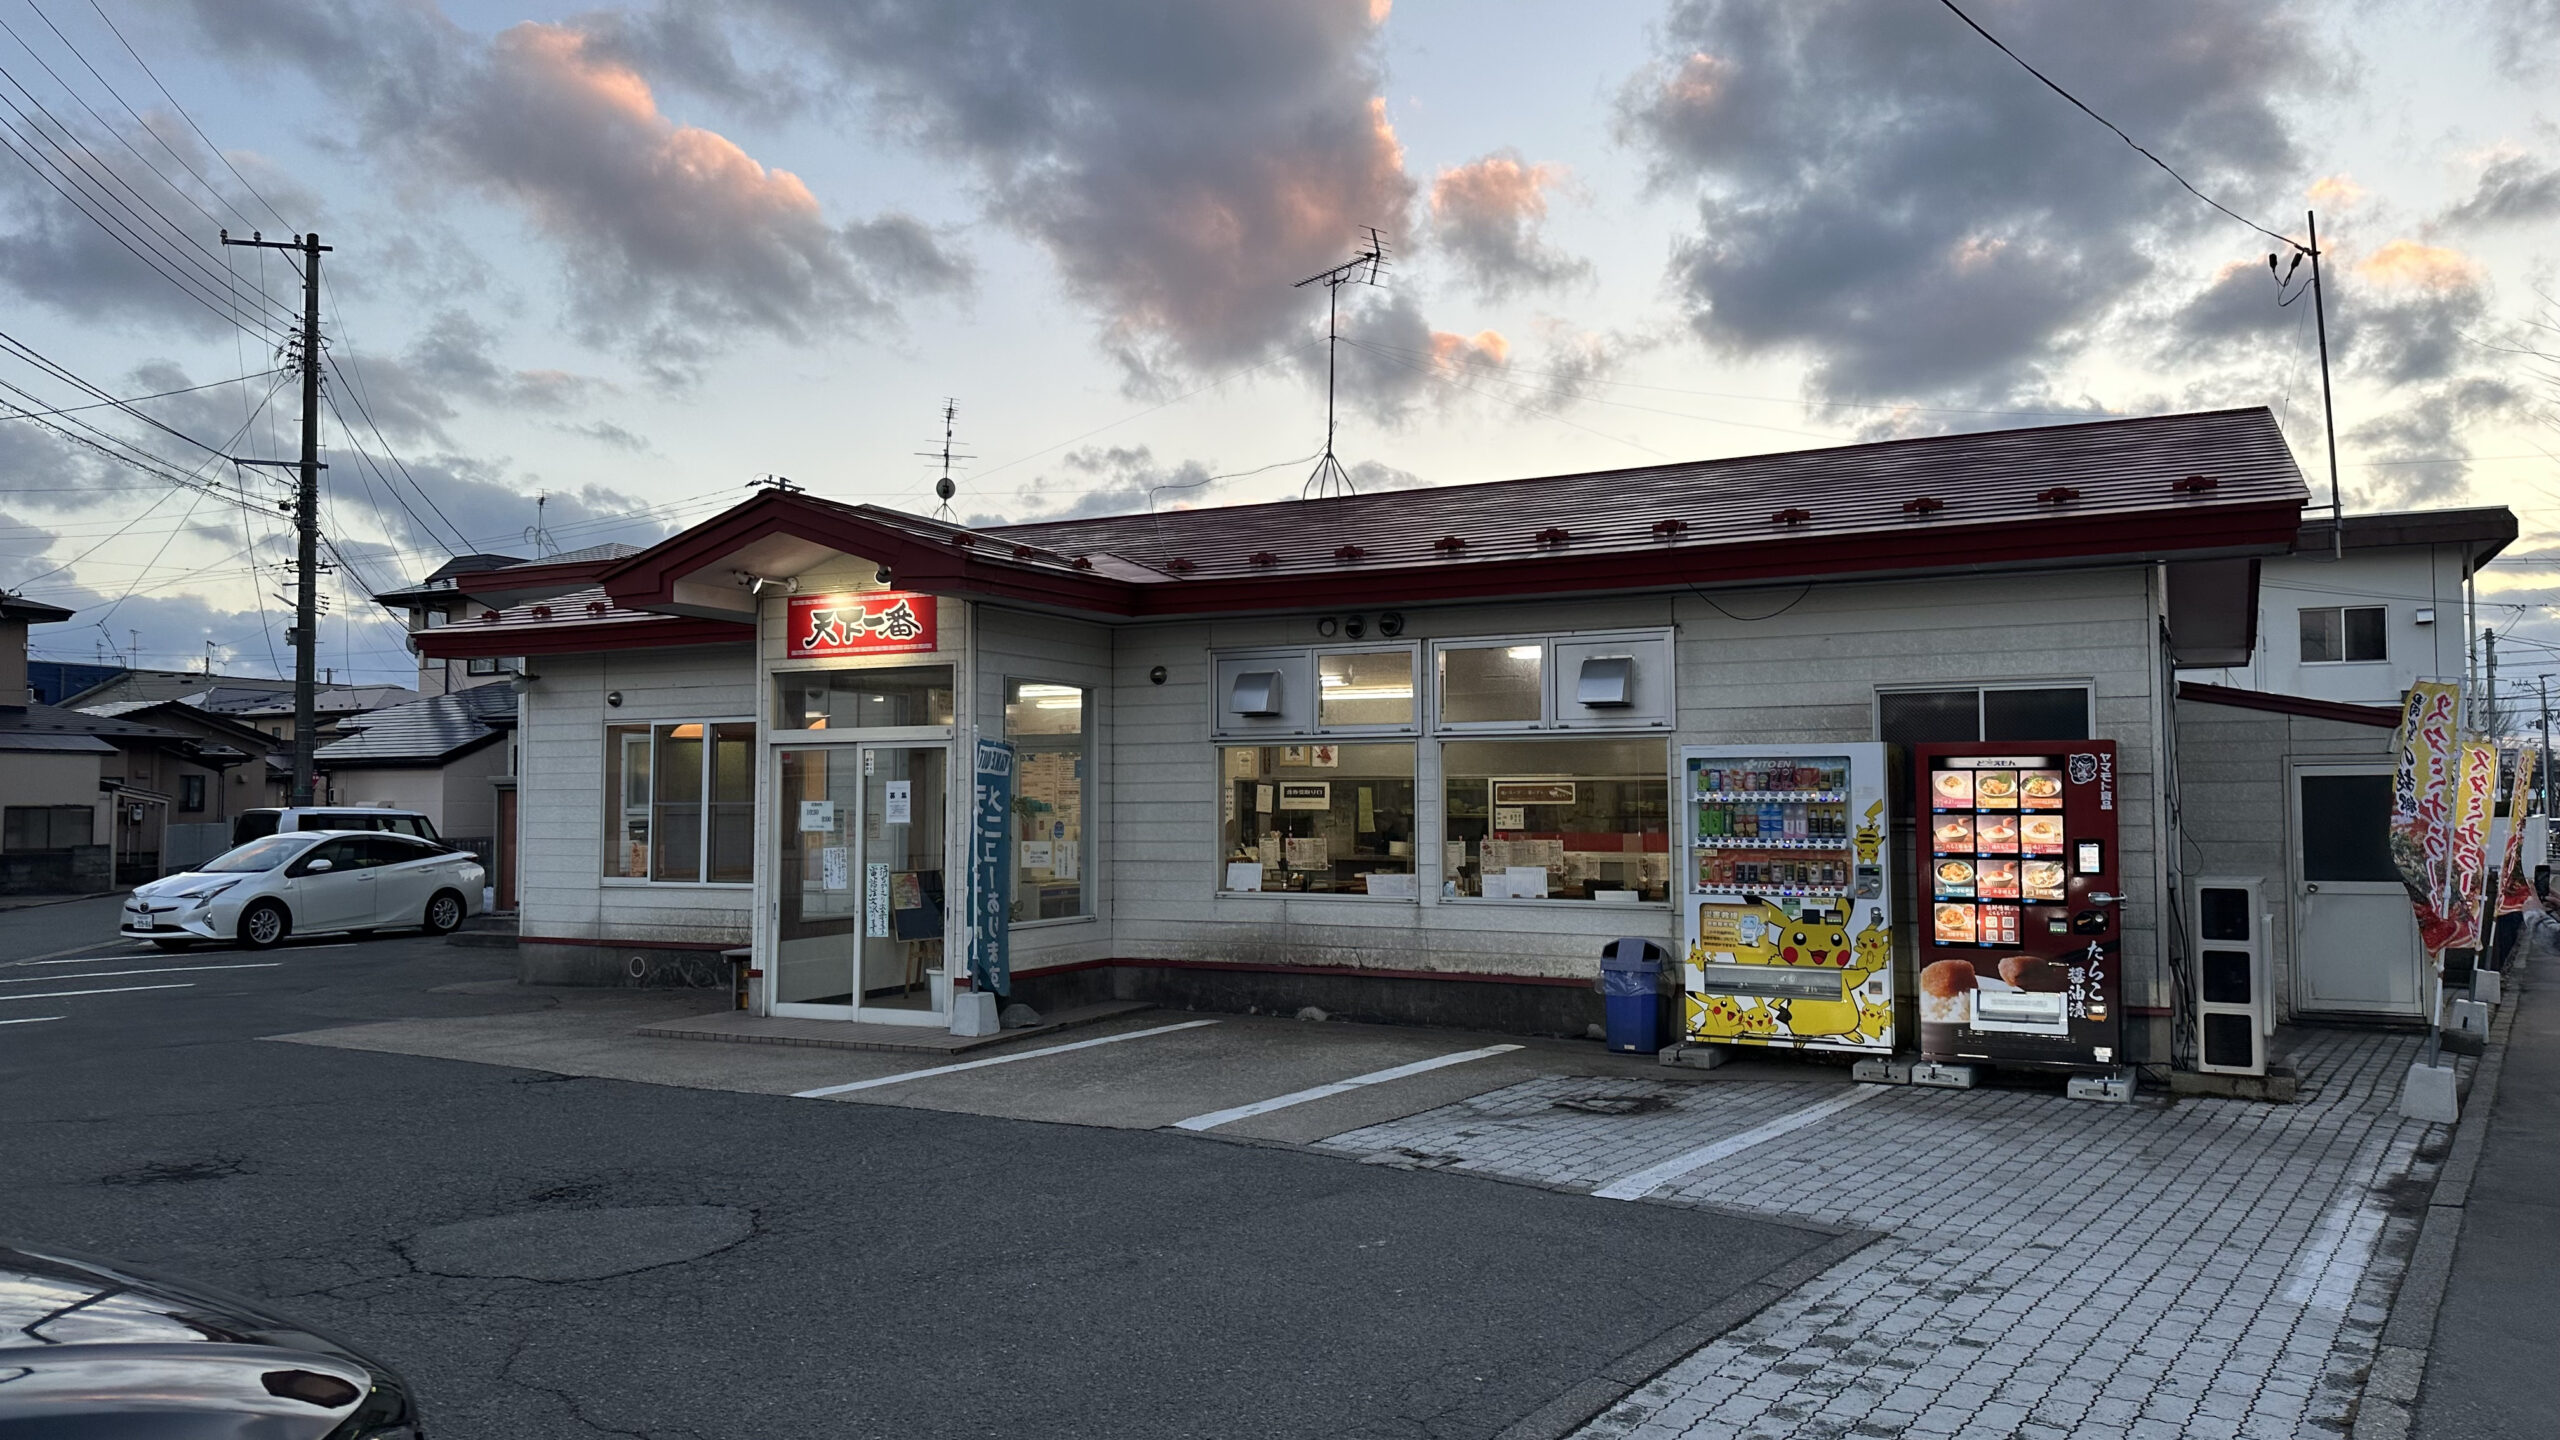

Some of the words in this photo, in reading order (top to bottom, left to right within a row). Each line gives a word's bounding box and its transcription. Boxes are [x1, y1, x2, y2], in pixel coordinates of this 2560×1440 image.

[803, 599, 923, 650] 天下一番
[1757, 760, 1776, 769] ITO
[1777, 759, 1792, 768] EN
[2099, 753, 2113, 811] ヤマモト食品
[2067, 966, 2087, 1019] 醤油漬
[2086, 939, 2105, 1001] たらこ
